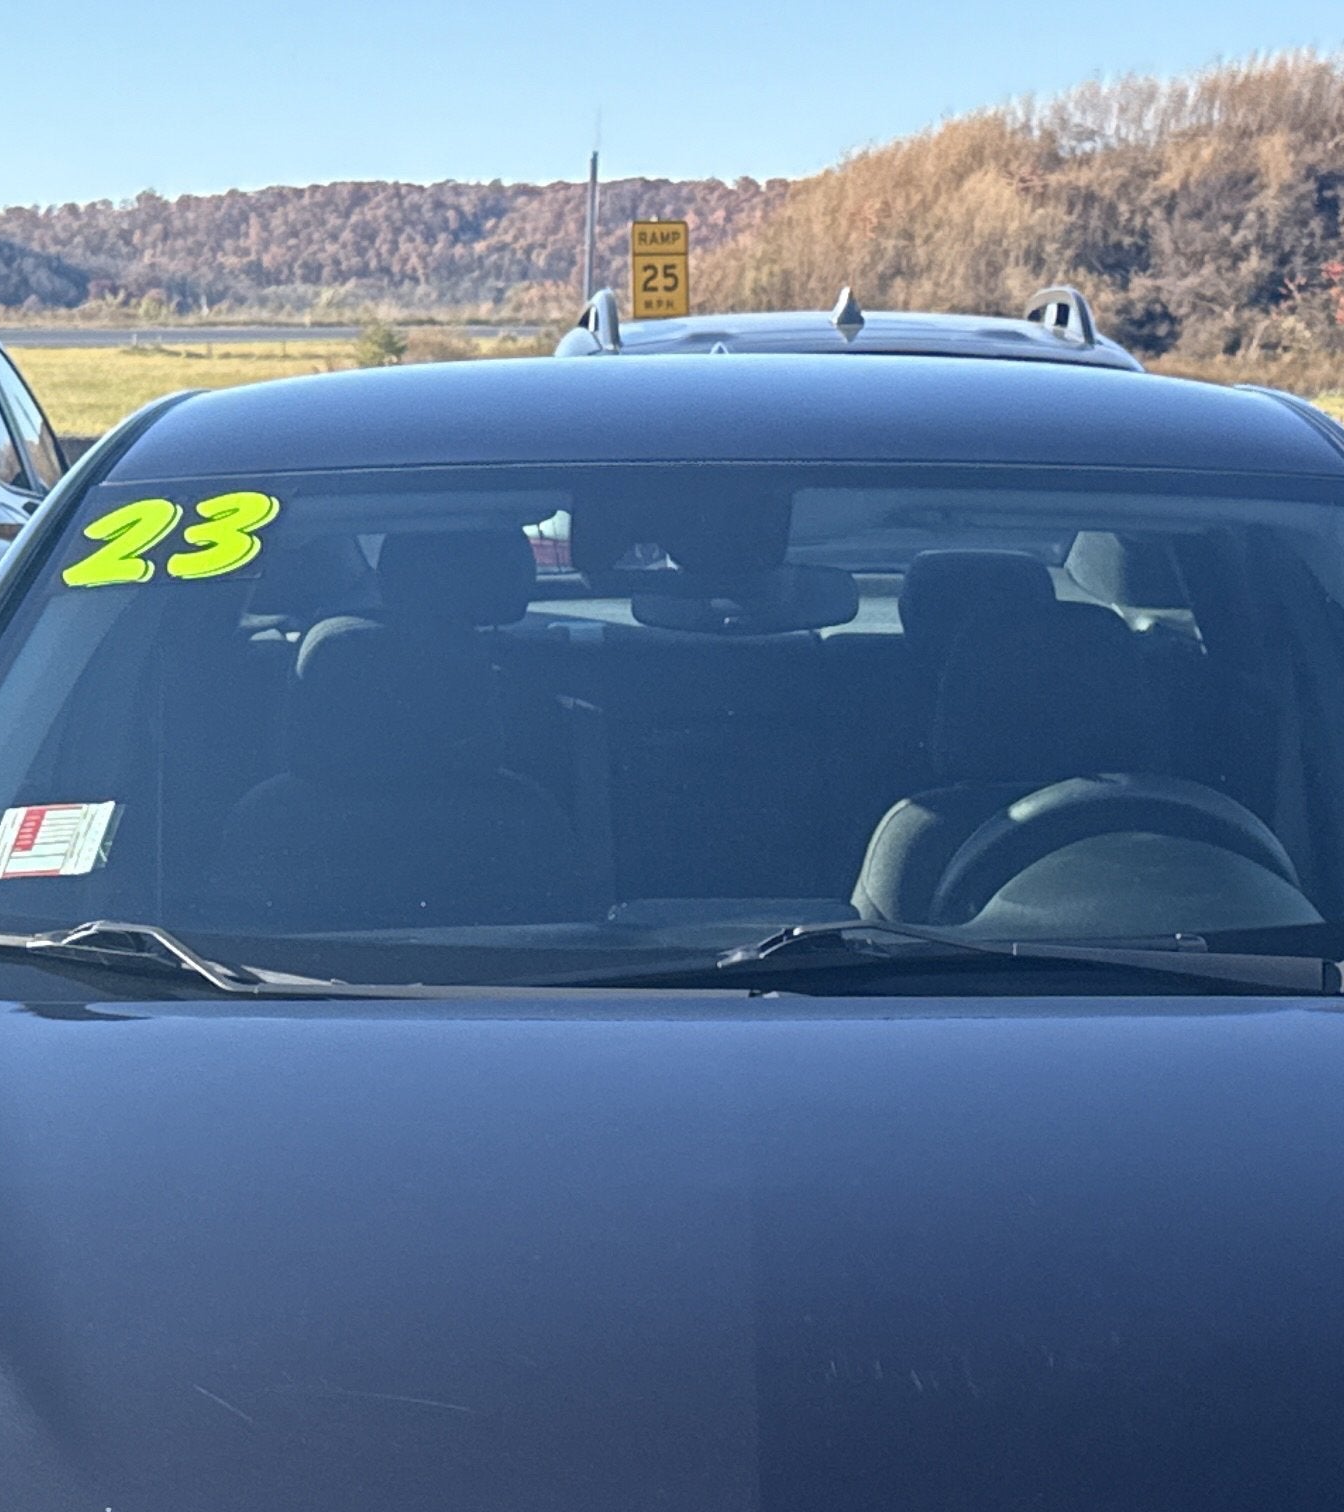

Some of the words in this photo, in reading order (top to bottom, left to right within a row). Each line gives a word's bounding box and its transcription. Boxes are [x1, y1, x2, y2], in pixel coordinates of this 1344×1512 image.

[638, 231, 681, 246] RAMP
[642, 264, 679, 292] 25
[644, 299, 674, 310] MPH
[62, 491, 280, 588] 23
